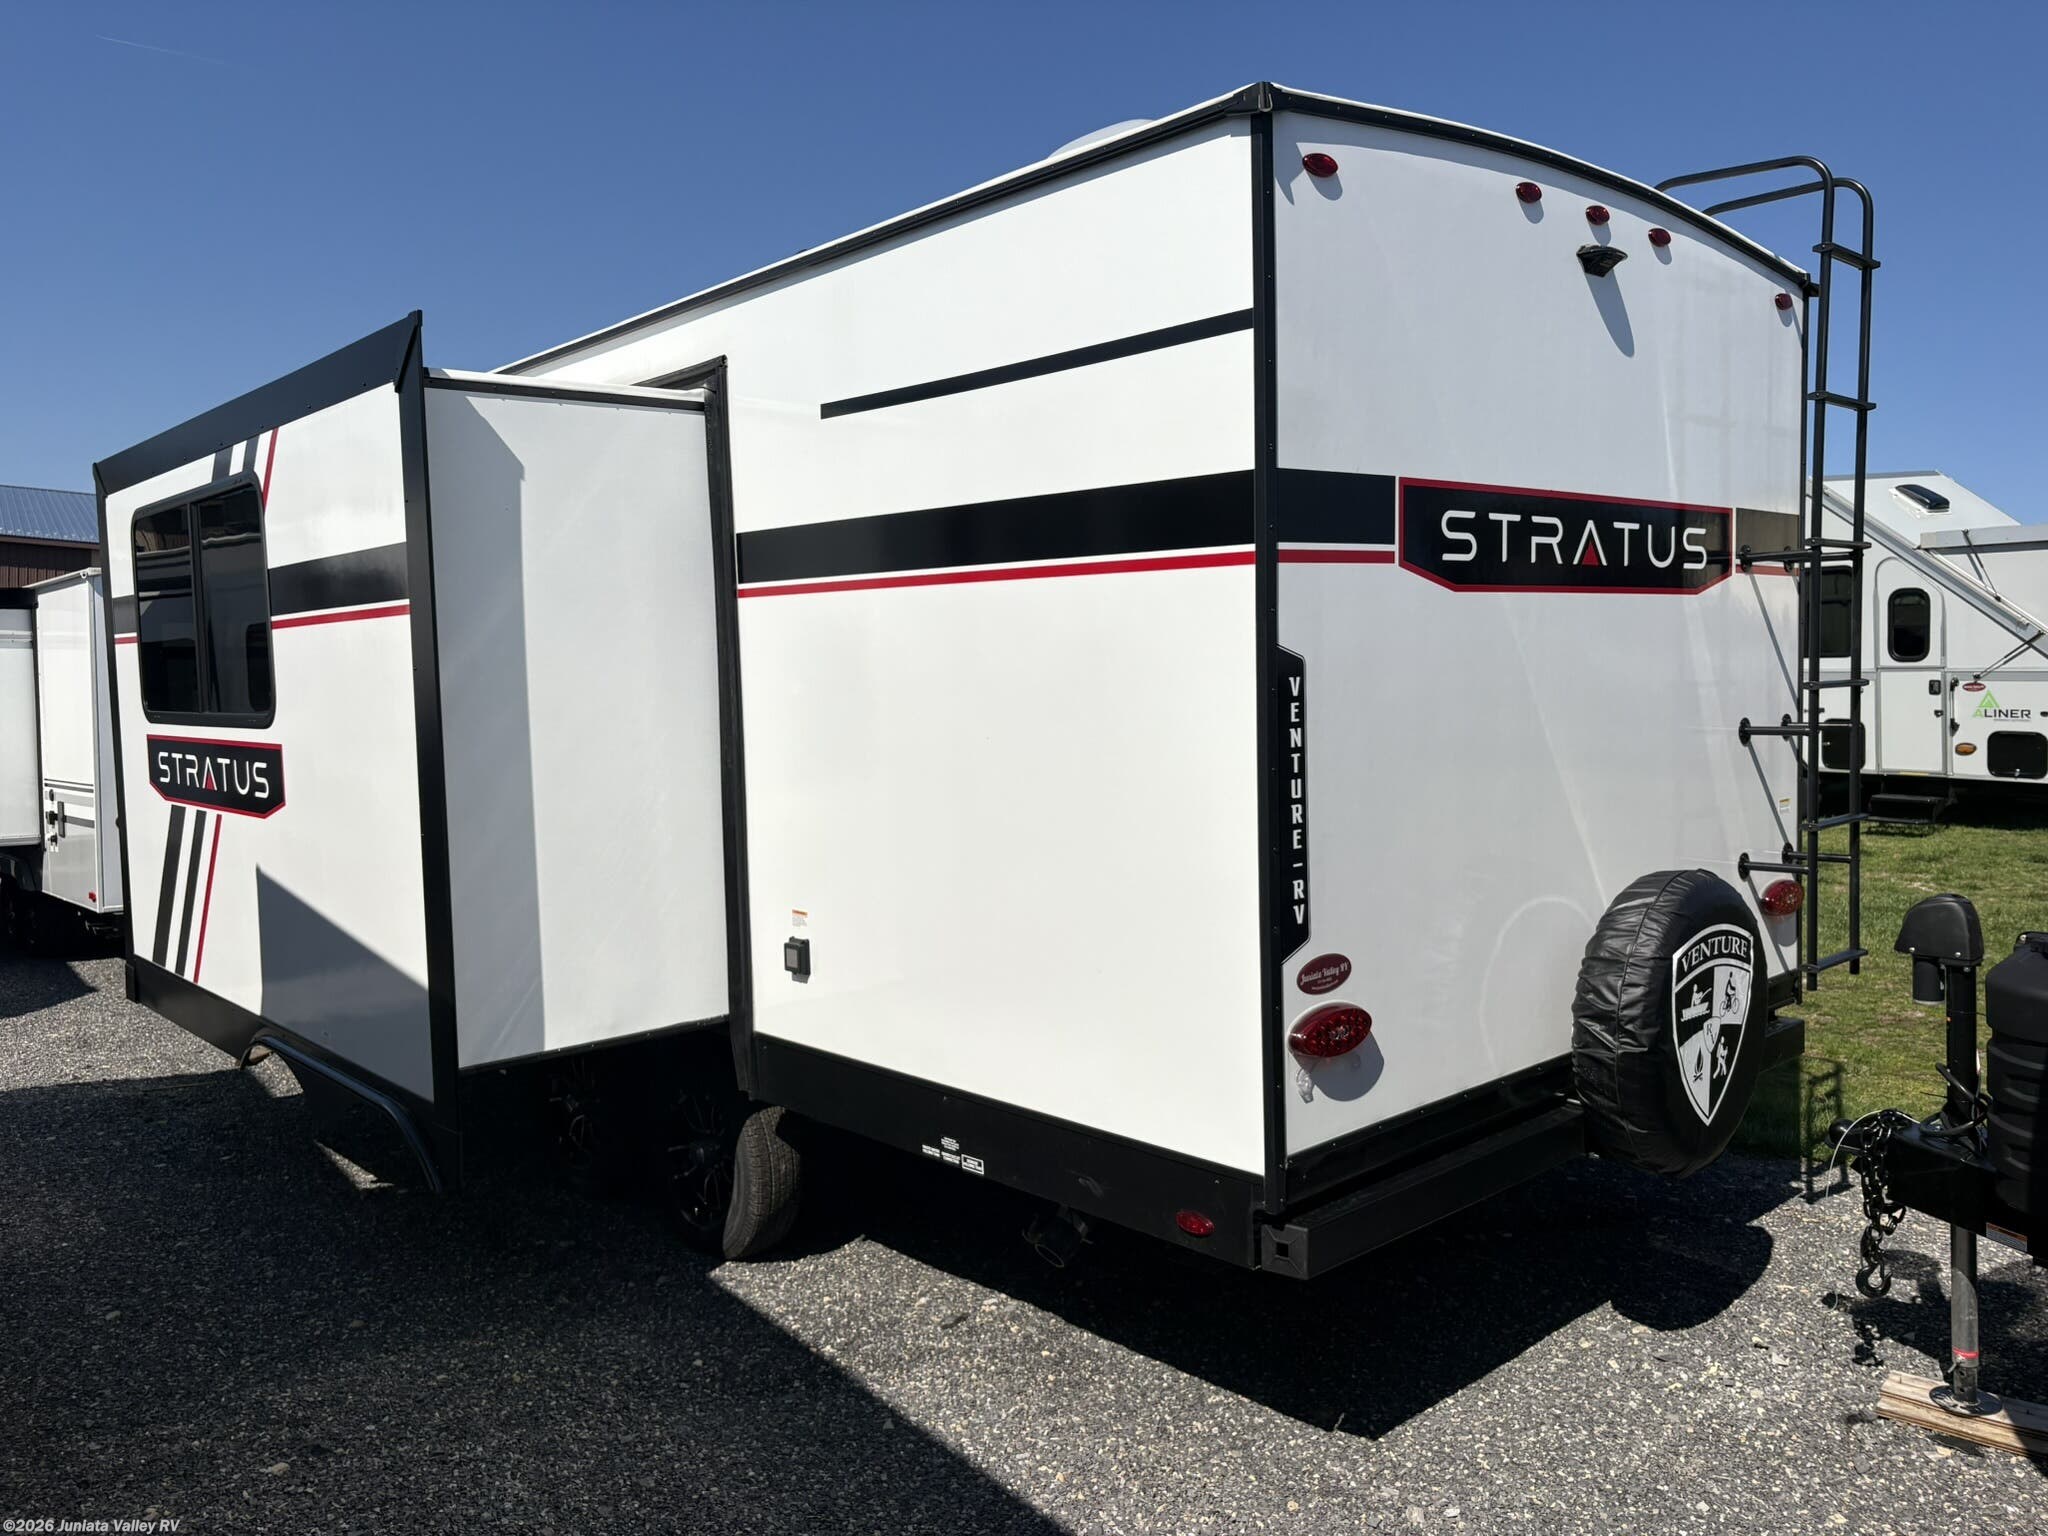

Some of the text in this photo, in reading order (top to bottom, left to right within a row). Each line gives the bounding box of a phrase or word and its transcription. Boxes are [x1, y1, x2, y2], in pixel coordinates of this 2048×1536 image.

[1440, 509, 1708, 571] STRATUS
[1973, 708, 2031, 719] ALINER
[158, 751, 270, 799] STRATUS
[1681, 935, 1748, 973] VENTURE
